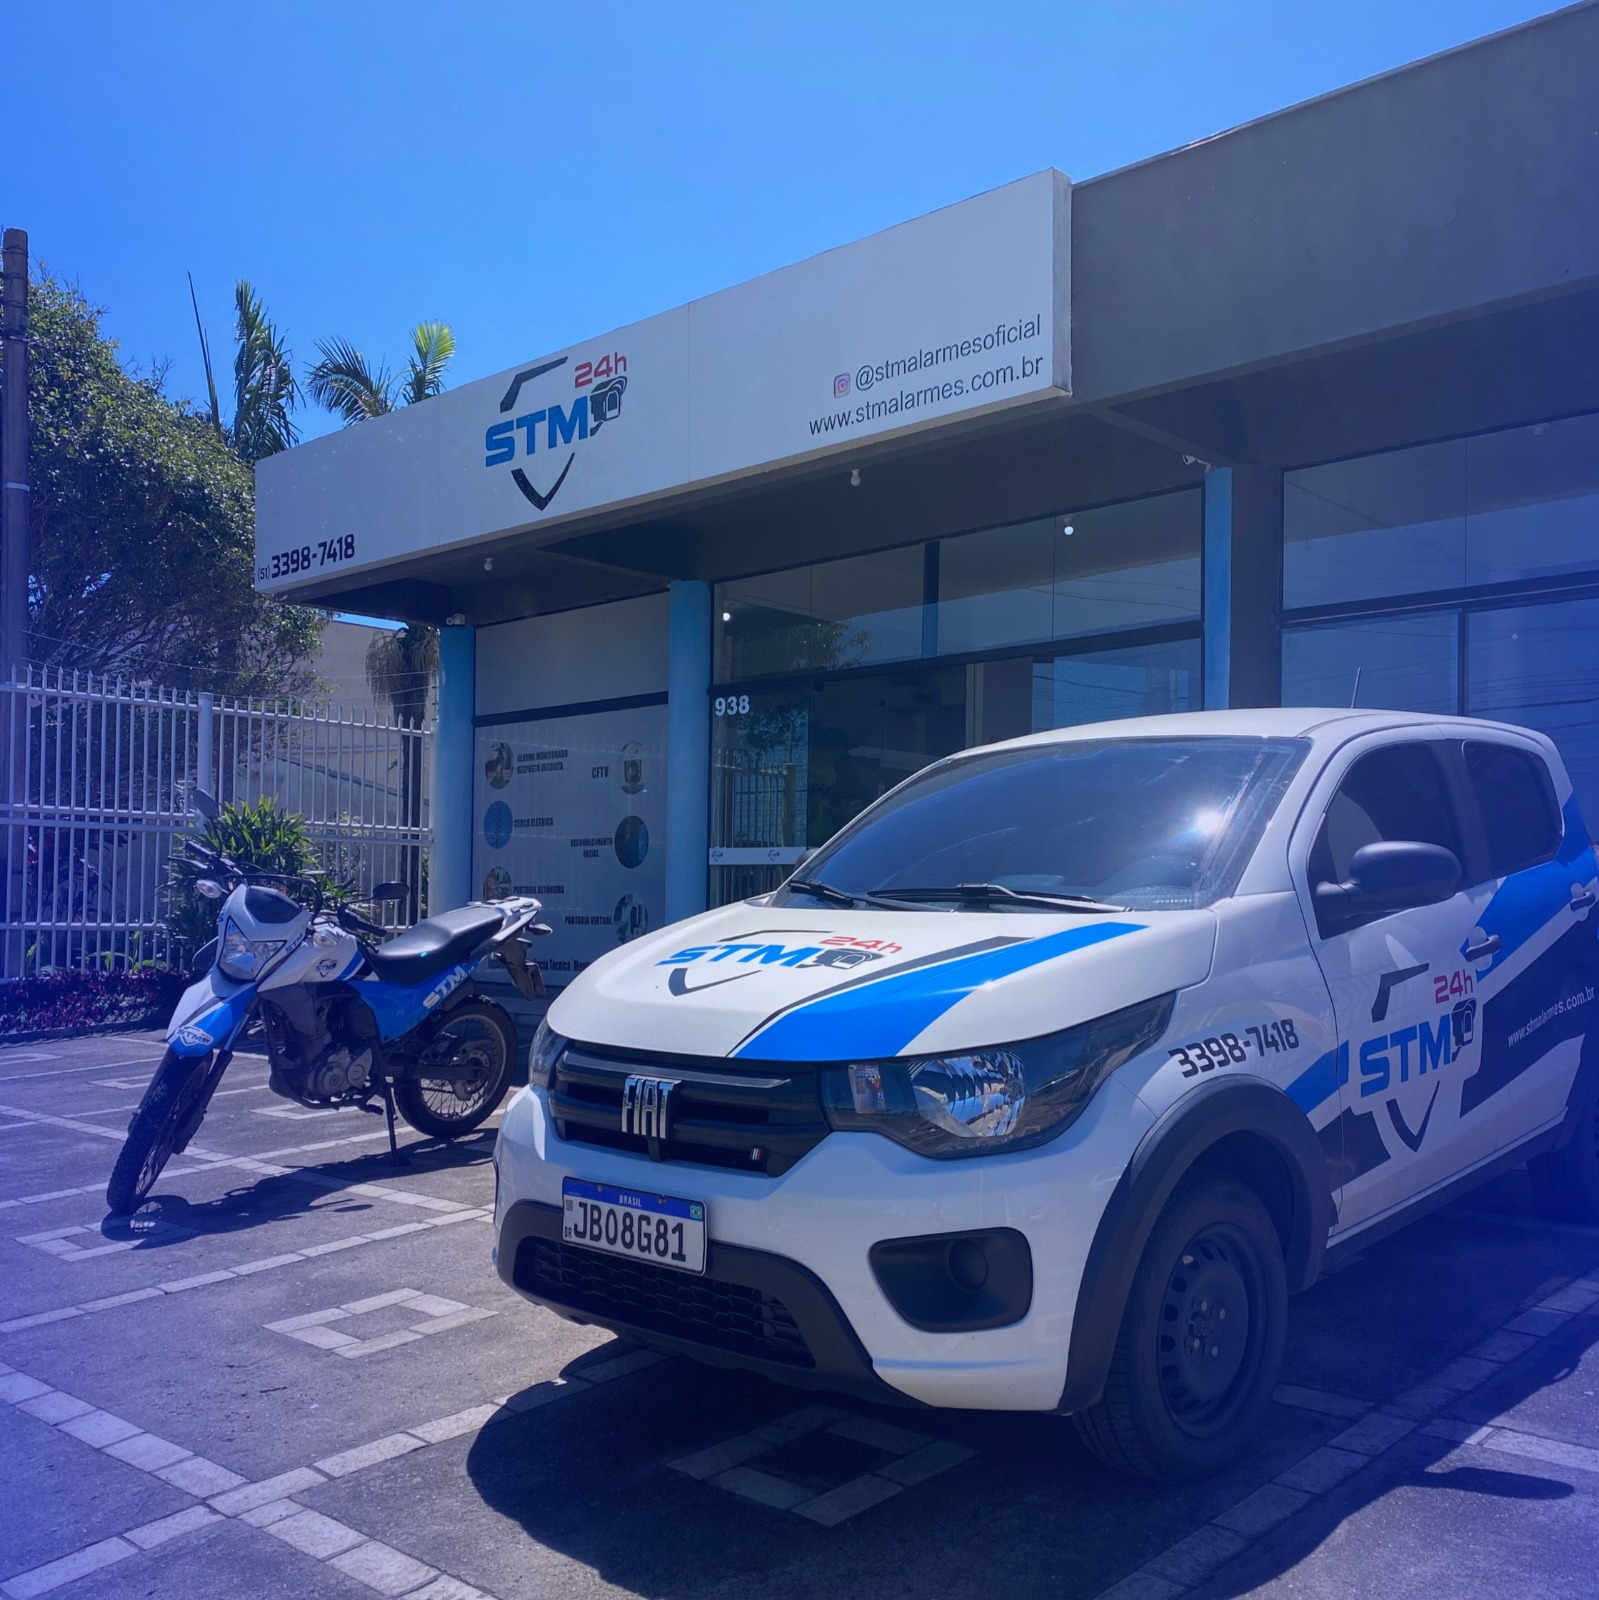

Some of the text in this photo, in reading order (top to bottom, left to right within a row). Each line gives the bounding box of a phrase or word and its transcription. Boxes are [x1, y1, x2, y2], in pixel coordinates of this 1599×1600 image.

[855, 314, 1041, 392] @stmalarmesoficial
[574, 352, 627, 389] 24h
[808, 356, 1044, 436] www.stmalarmes.com.br
[485, 395, 588, 468] STM
[257, 533, 355, 582] (51) 3398-7418
[715, 694, 750, 717] 938
[517, 764, 541, 774] RESPOSTA
[591, 765, 609, 779] CFTV
[514, 818, 530, 828] CERCA
[583, 849, 600, 858] FACIAL
[513, 885, 537, 895] PORTARIA
[564, 915, 612, 925] PORTARIA VIRTUAL
[654, 943, 826, 967] STM
[818, 936, 903, 954] 24h
[1433, 969, 1473, 1004] 24h
[1508, 986, 1595, 1048] www.stmalarmes.com.br
[1168, 1018, 1300, 1079] 3398-7418
[1359, 1013, 1451, 1098] STM
[621, 1074, 682, 1139] FIAT
[619, 1194, 642, 1208] BRASIL
